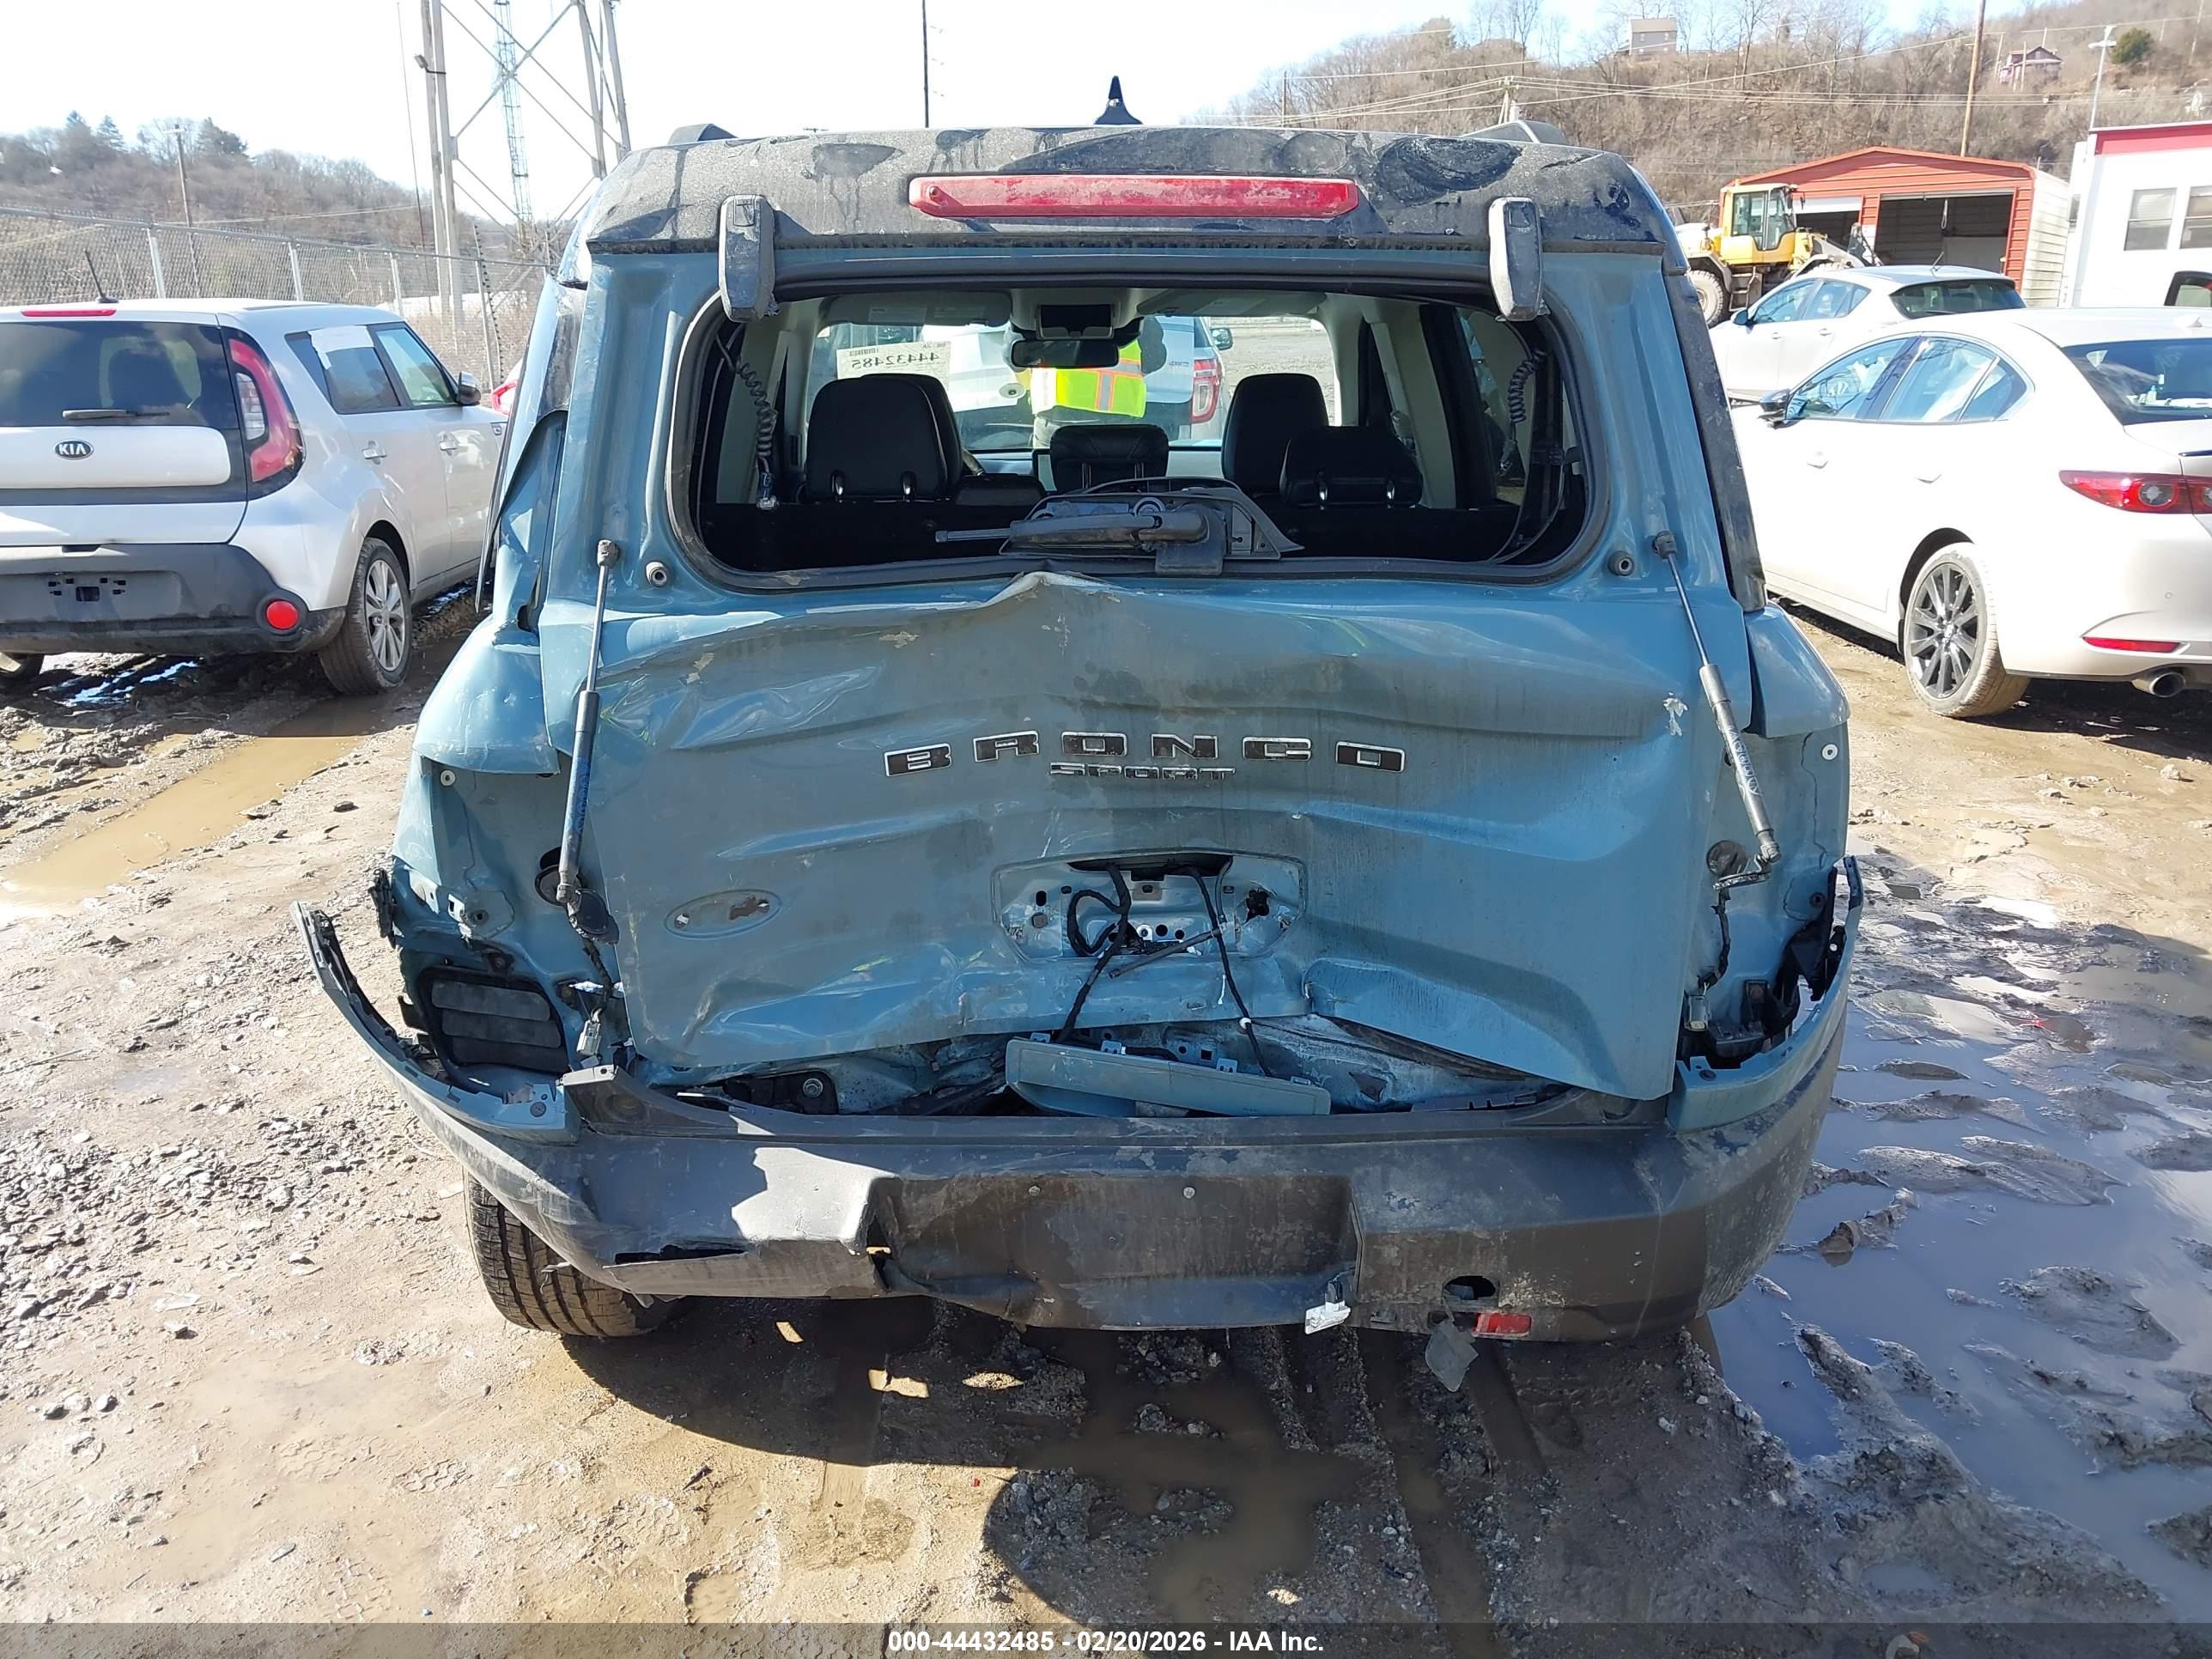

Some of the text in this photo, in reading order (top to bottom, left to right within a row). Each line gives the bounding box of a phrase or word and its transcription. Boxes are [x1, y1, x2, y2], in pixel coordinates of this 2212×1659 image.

[59, 443, 87, 455] KIA
[884, 730, 1406, 777] BRONCO
[1050, 762, 1236, 781] SPORT
